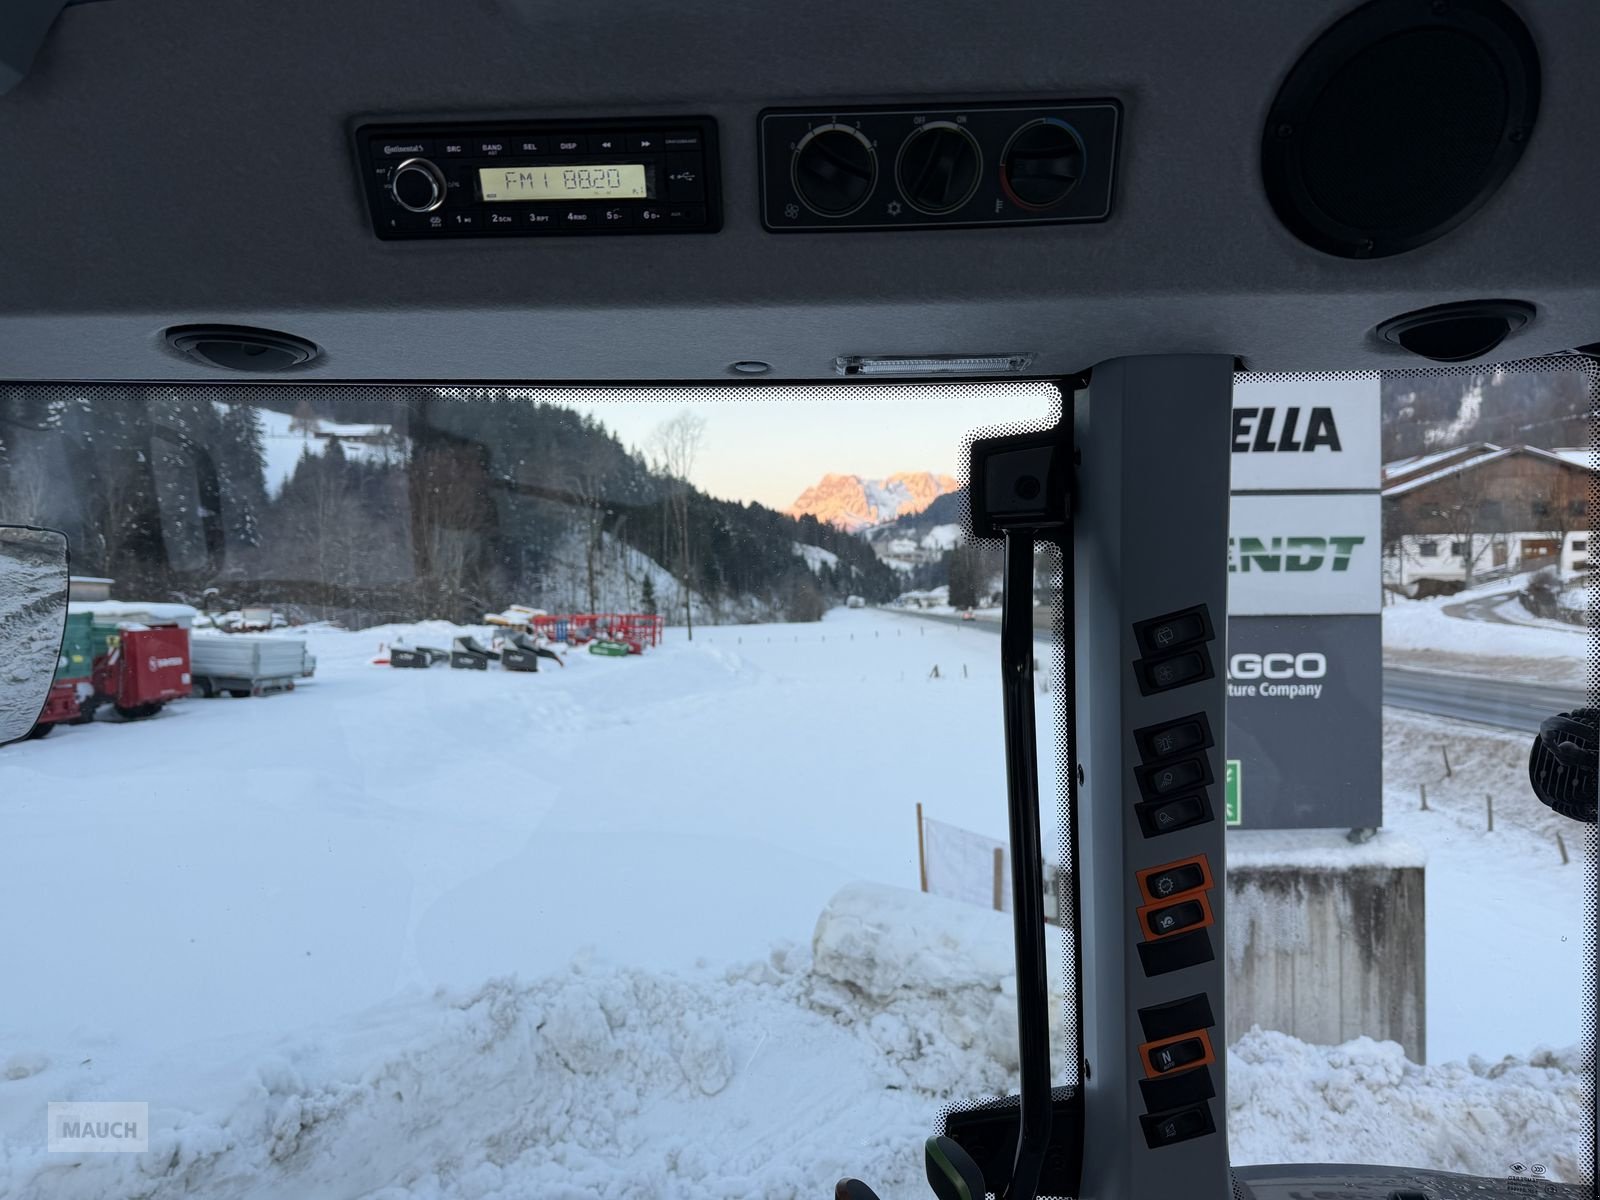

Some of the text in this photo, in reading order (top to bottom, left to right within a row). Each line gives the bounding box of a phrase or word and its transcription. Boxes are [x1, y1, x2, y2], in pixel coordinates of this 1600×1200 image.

[914, 116, 926, 124] OFF
[560, 142, 577, 150] DISP
[1232, 407, 1342, 452] ELLA
[1227, 652, 1326, 679] GCO
[1260, 682, 1322, 700] Company
[1161, 1050, 1172, 1064] N
